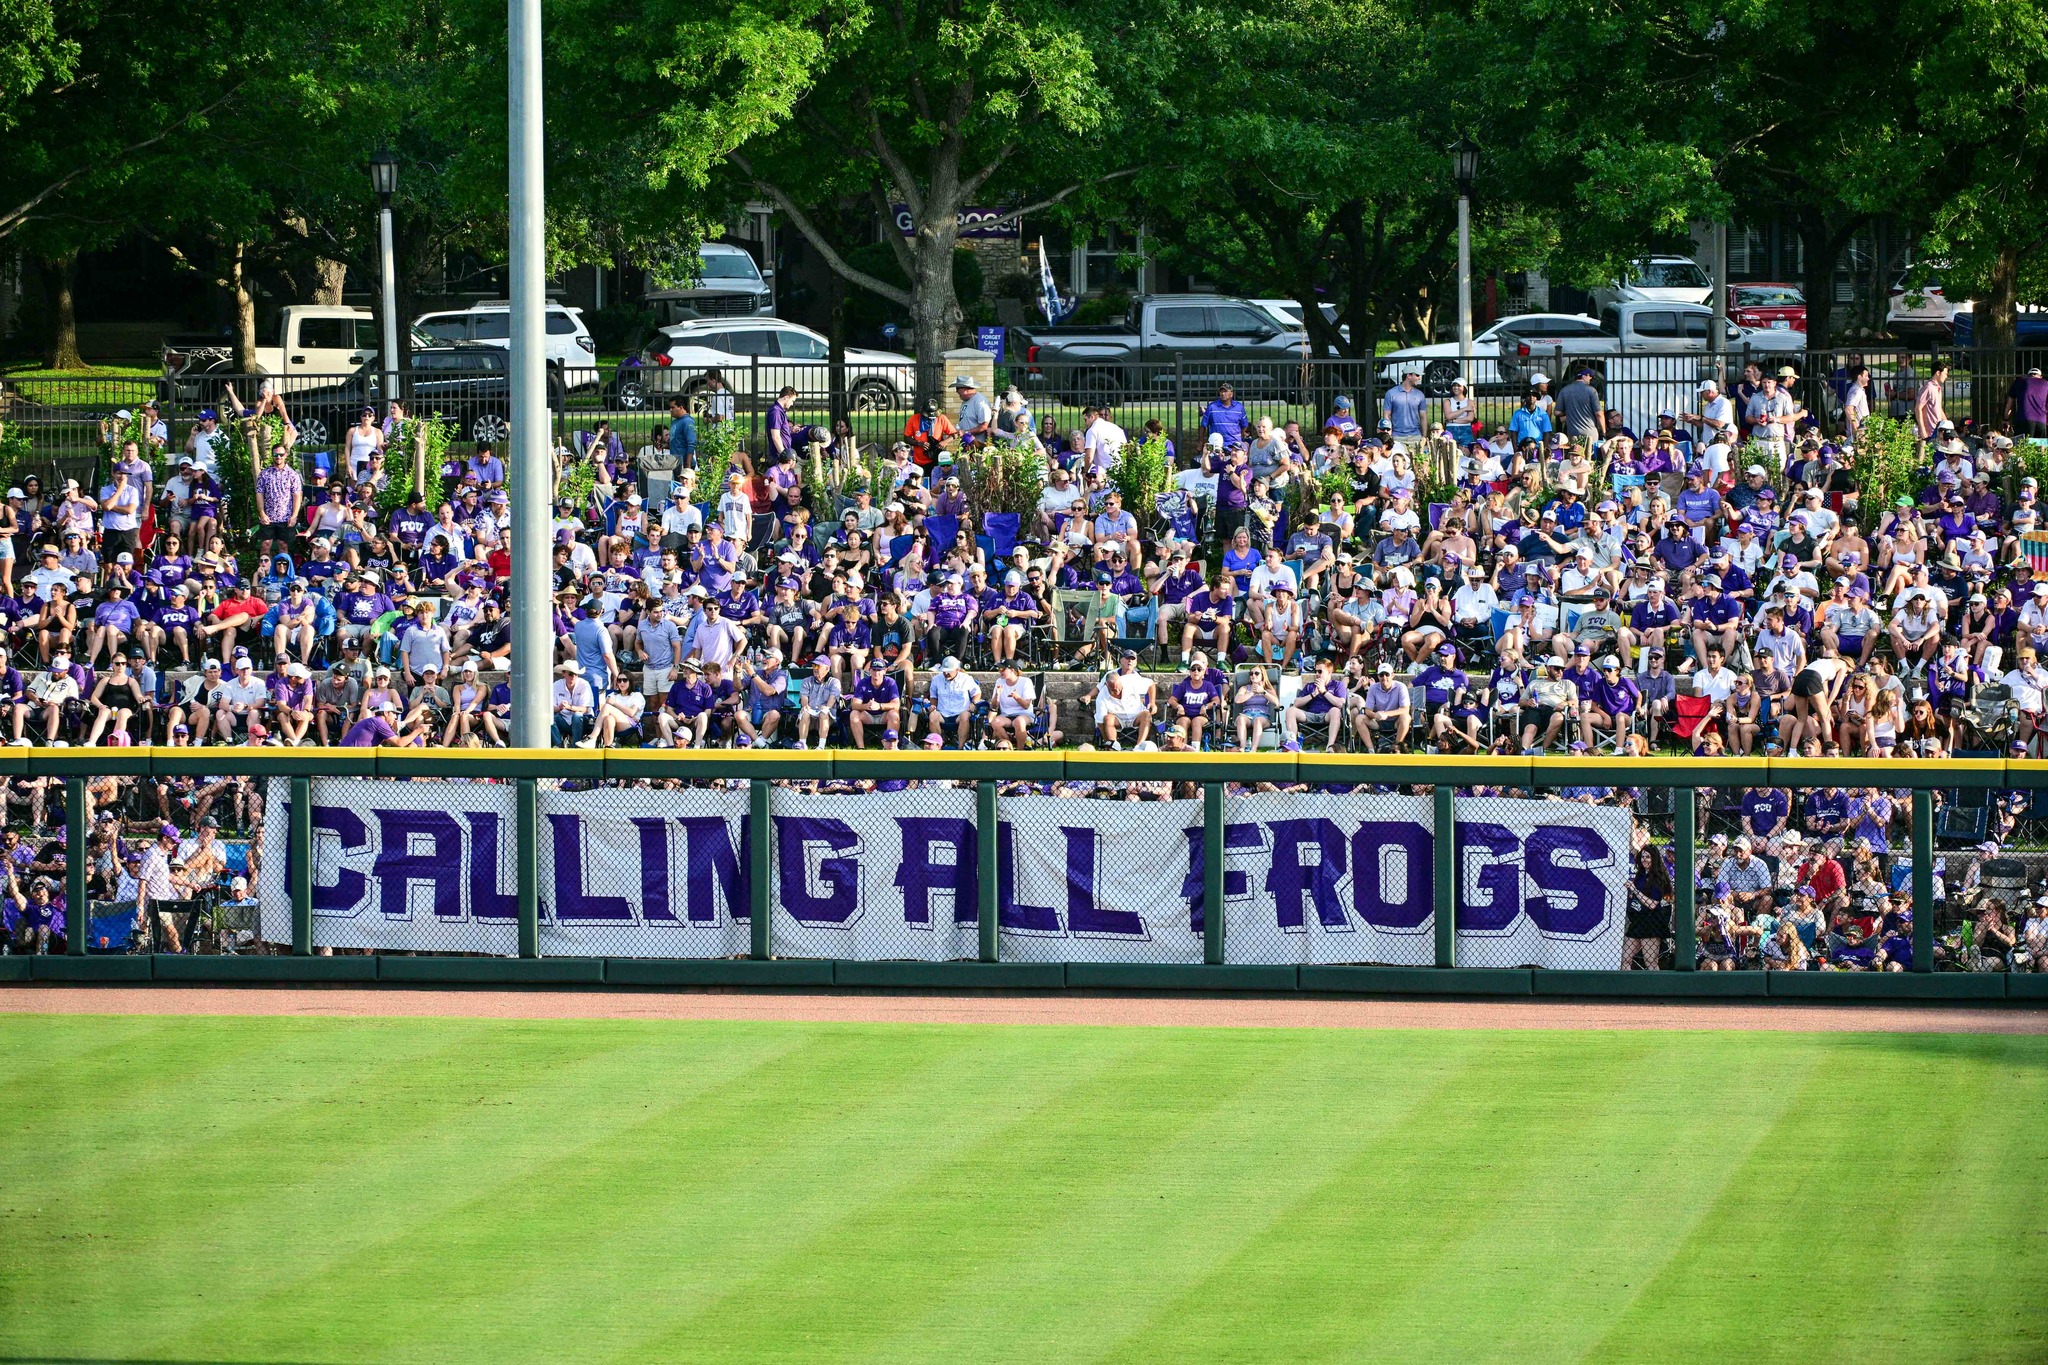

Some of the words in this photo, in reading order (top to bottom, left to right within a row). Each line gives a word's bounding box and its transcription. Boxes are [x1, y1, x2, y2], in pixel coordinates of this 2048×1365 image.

[957, 212, 1018, 232] OGS!
[400, 521, 425, 533] TCU
[367, 557, 389, 568] TCU
[941, 598, 966, 607] TCU
[162, 612, 189, 623] TCU
[454, 605, 476, 621] TCU
[1588, 617, 1607, 626] TCU
[1754, 802, 1772, 813] TCU
[283, 801, 865, 930] CALLING
[893, 815, 1152, 942] ALL
[1180, 817, 1616, 943] FROGS
